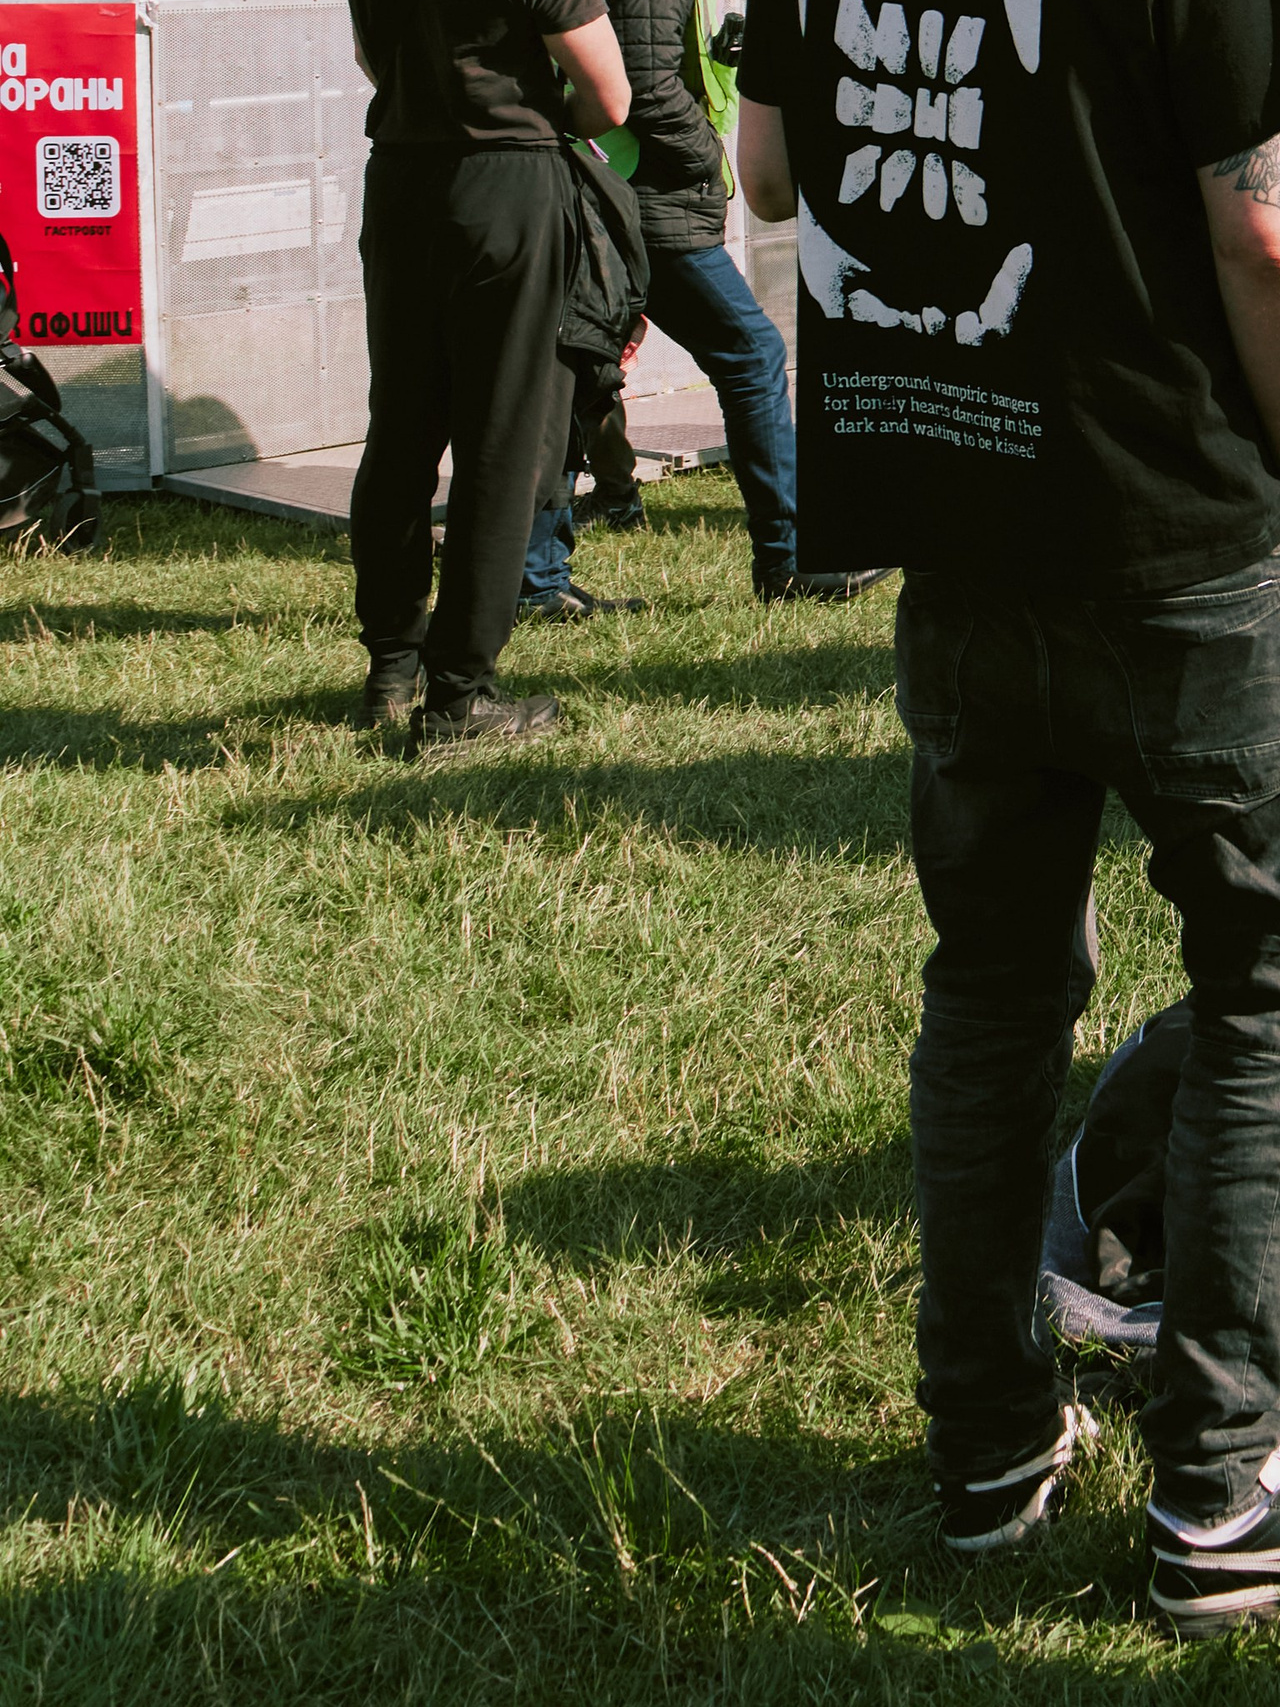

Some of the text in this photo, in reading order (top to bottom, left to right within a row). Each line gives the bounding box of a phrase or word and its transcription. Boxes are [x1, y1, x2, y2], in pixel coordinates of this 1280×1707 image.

[45, 225, 112, 236] ГАСТРОБОТ
[822, 372, 1039, 414] Underground vampiric bangers
[824, 395, 1042, 437] for lonely hearts dancing in the
[834, 417, 1036, 459] dark and waiting to be kissed
